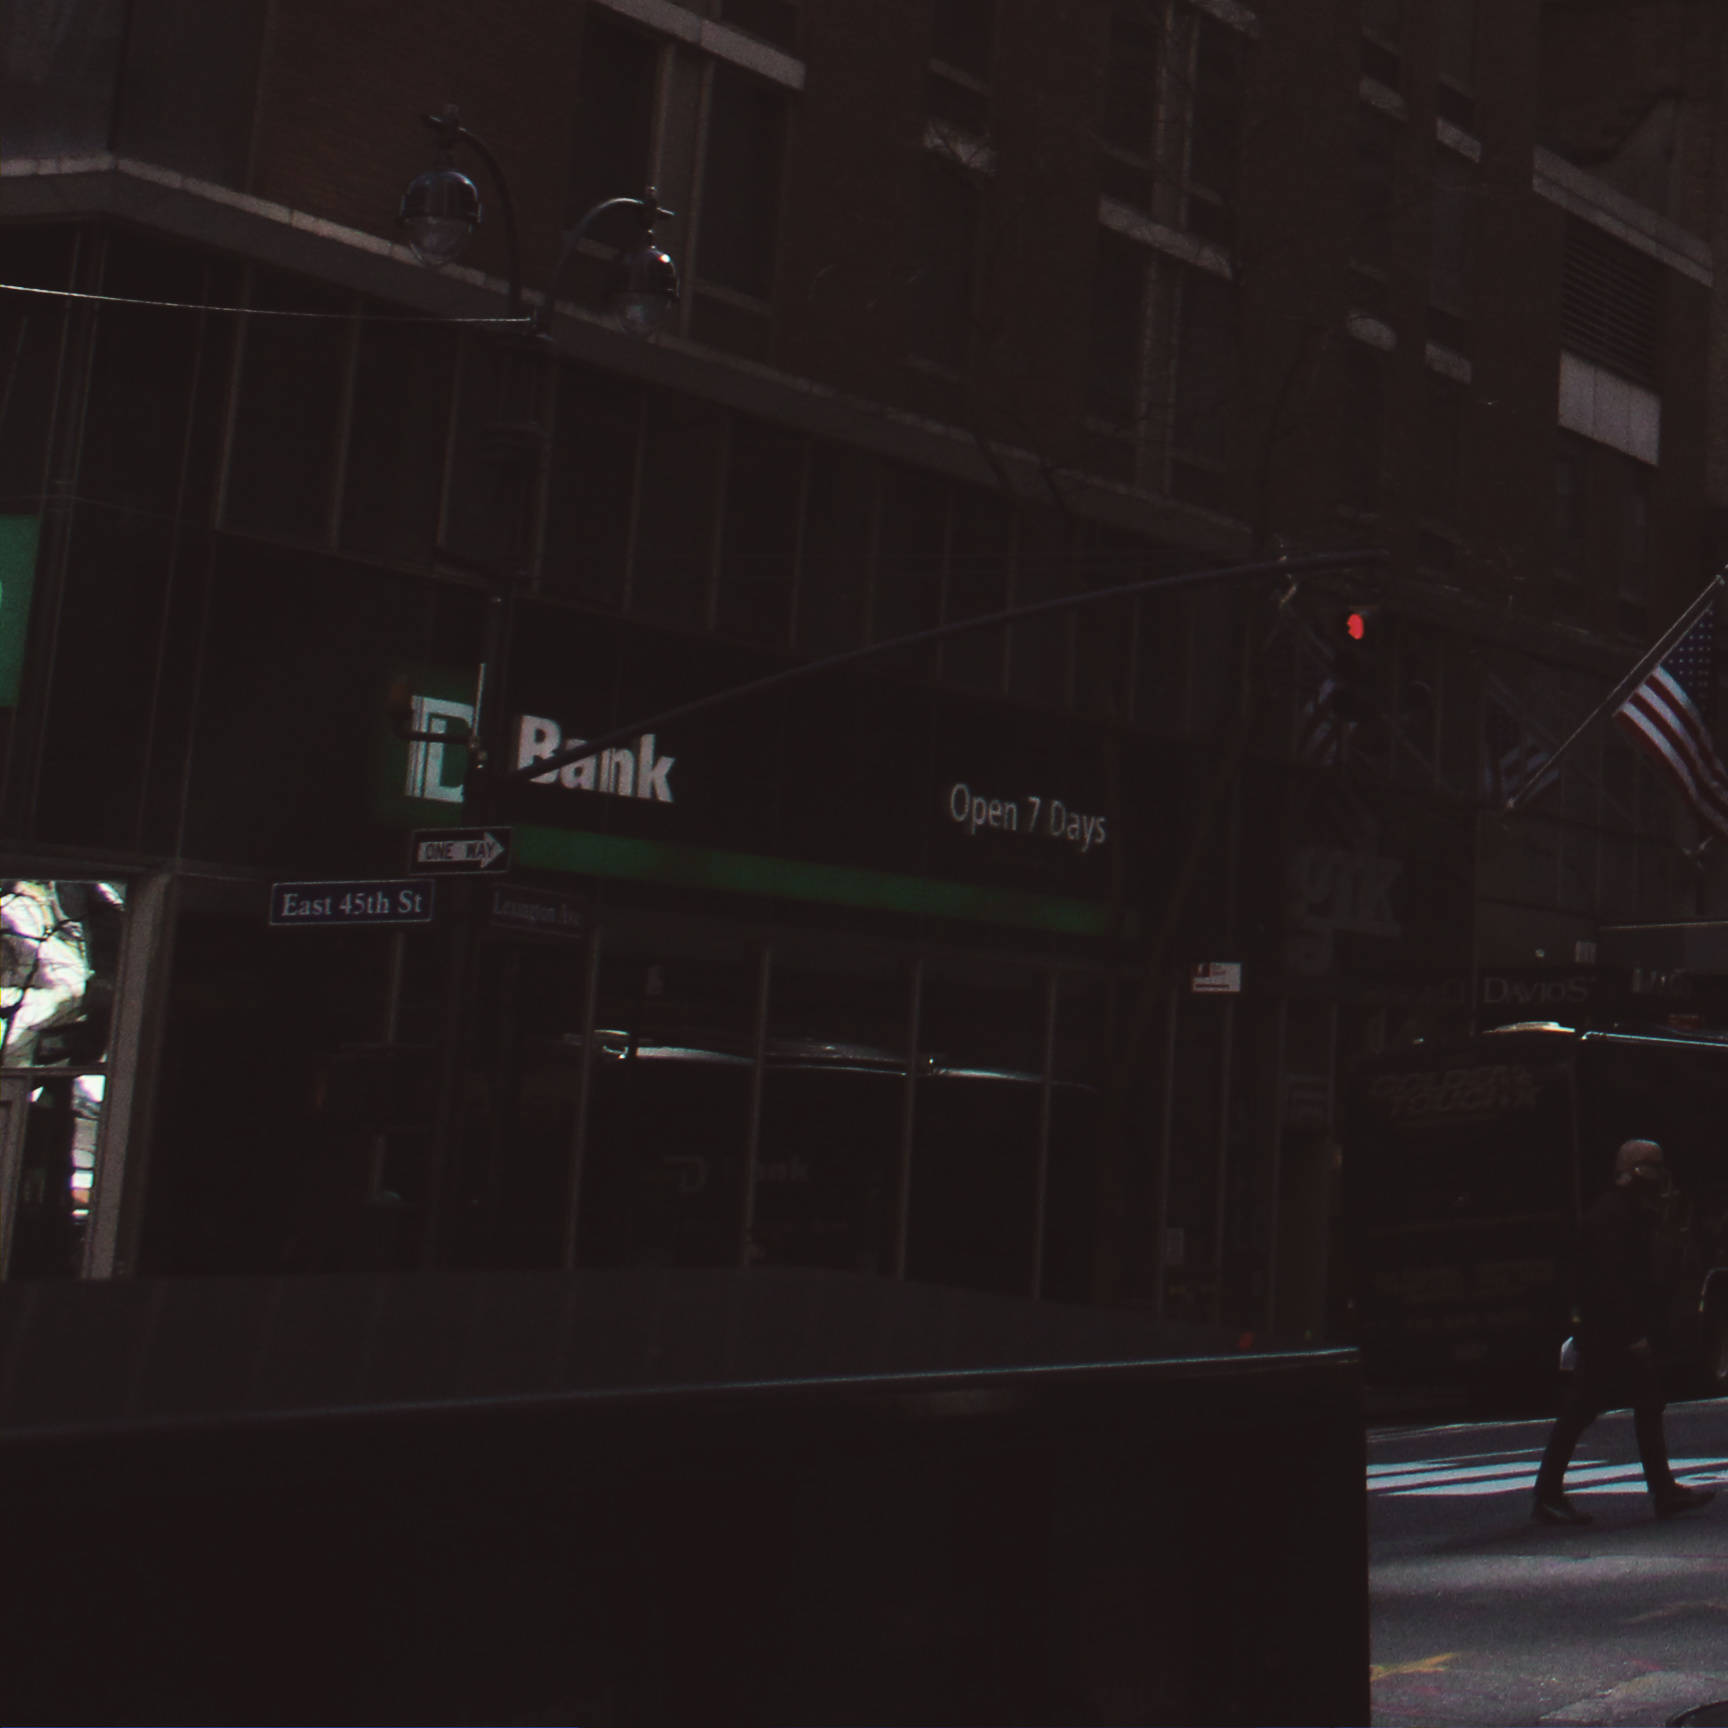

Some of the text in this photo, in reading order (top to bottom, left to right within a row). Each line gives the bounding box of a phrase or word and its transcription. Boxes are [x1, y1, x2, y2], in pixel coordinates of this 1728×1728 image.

[516, 713, 678, 804] Bank
[949, 782, 1108, 854] Open 7 Days
[425, 840, 497, 859] ONE WAY
[281, 888, 424, 918] East 45th St
